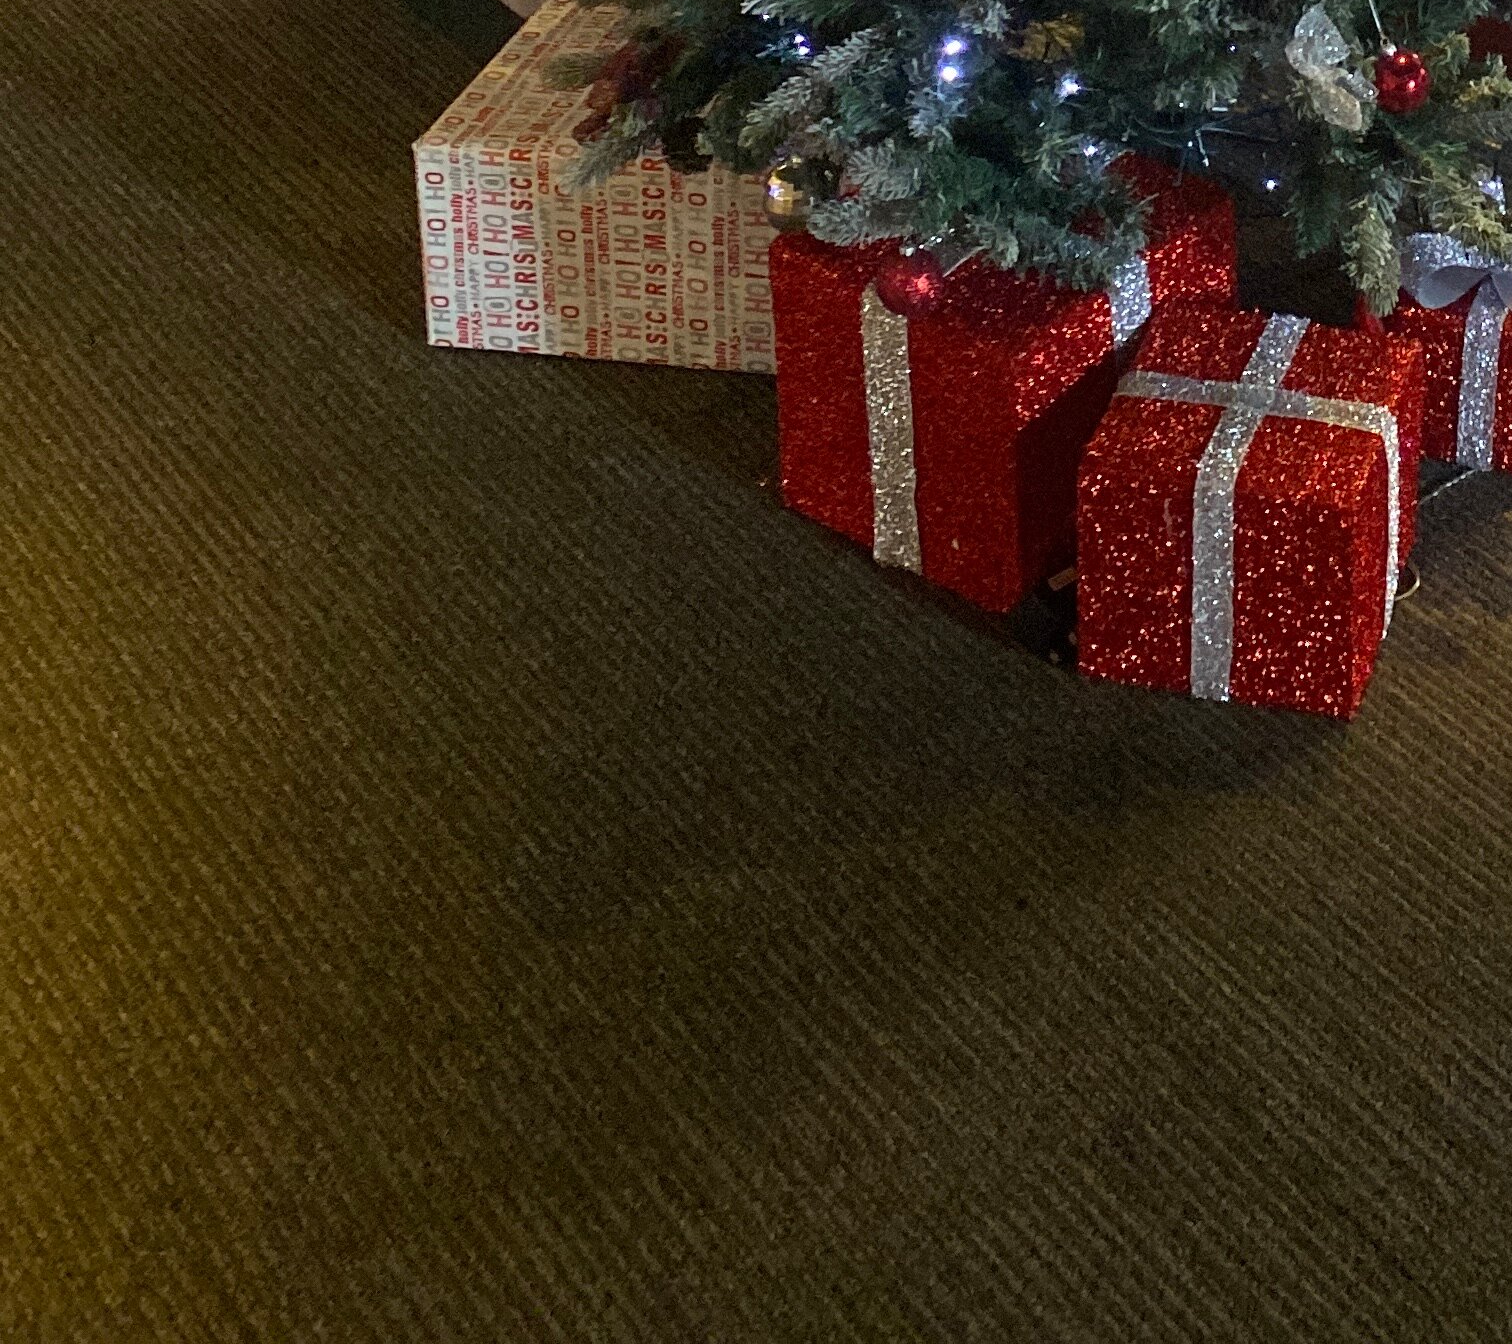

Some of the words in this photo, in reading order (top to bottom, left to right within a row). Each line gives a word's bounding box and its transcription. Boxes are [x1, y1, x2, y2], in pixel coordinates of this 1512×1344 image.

[424, 172, 445, 200] HO
[478, 172, 506, 206] HO
[450, 193, 463, 223] holly
[465, 188, 479, 255] CHRISTMAS
[580, 205, 594, 234] holly
[686, 192, 708, 221] HO
[482, 214, 508, 244] HO
[597, 199, 610, 265] CHRISTMAS
[612, 224, 640, 253] HO
[711, 215, 725, 246] holly
[727, 210, 740, 278] CHRISTMAS
[427, 255, 449, 288] HO
[483, 250, 511, 288] HO!
[541, 249, 556, 316] CHRISTMAS
[557, 265, 579, 297] HO
[614, 259, 641, 300] HO!
[430, 295, 451, 323] HO
[671, 261, 684, 329] CHRISTMAS
[686, 278, 708, 310] HO
[482, 297, 513, 328] HO
[559, 305, 580, 333] HO
[456, 316, 469, 344] holly
[688, 318, 709, 346] HO
